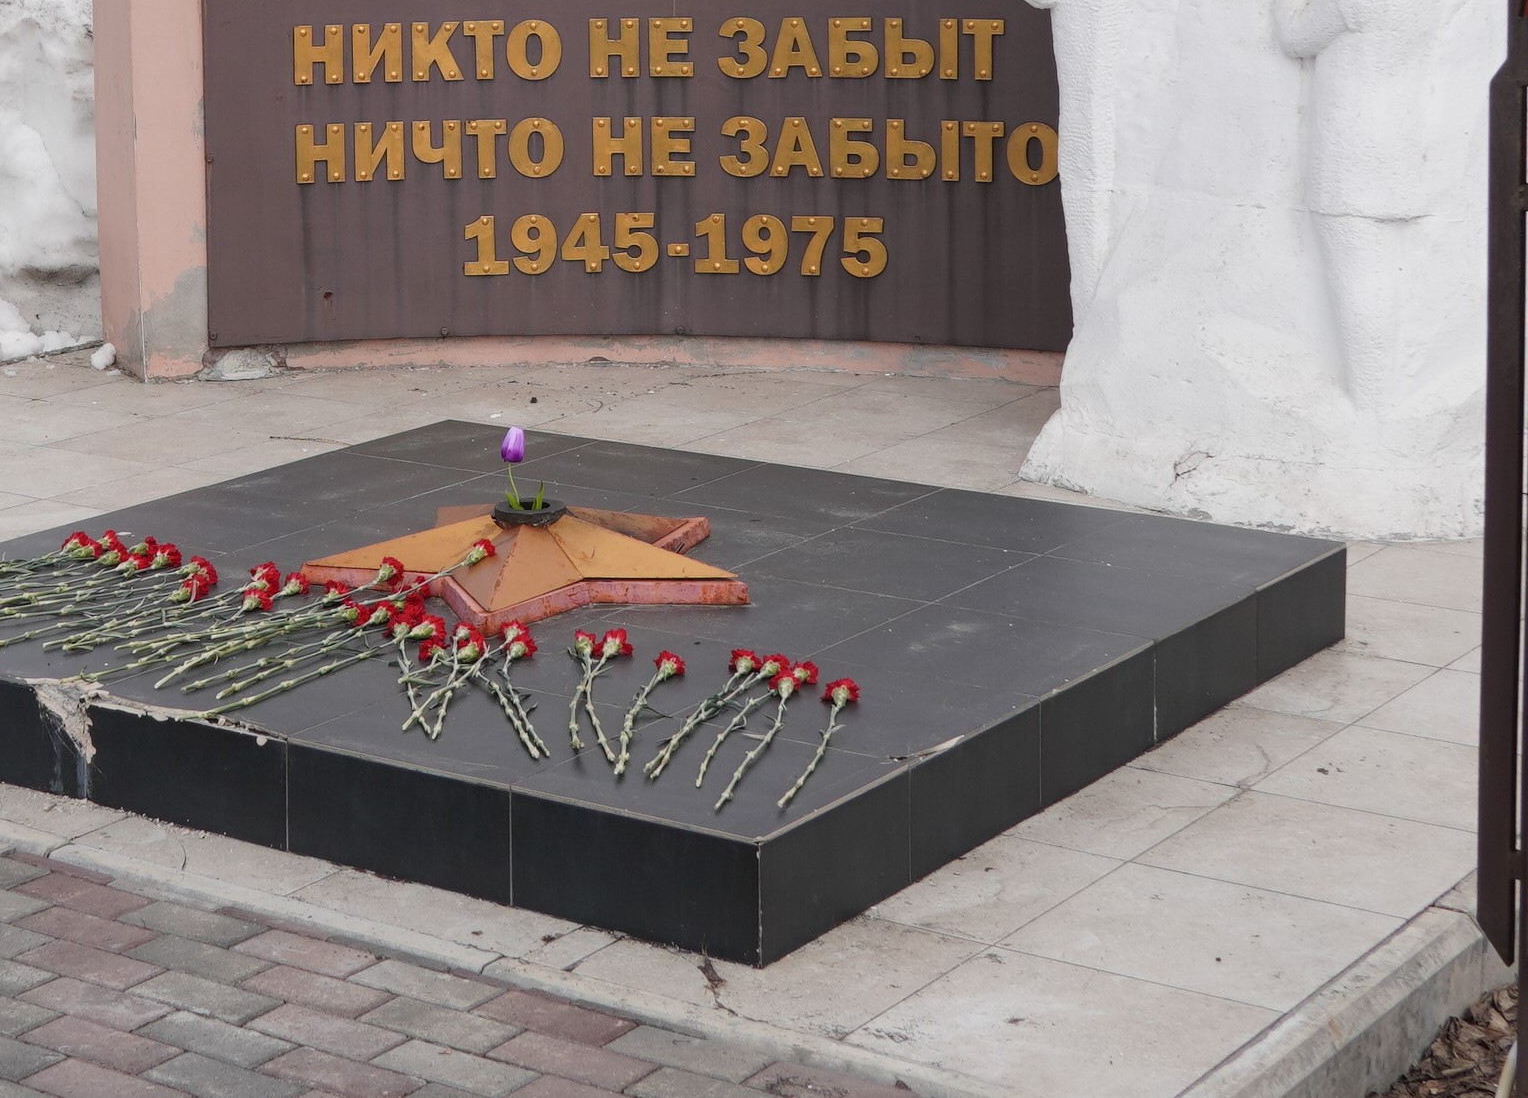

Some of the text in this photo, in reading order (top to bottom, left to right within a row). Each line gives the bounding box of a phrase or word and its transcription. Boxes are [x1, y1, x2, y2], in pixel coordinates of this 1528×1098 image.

[293, 16, 1005, 86] НИКТО НЕ ЗАБЫТ
[295, 115, 1060, 186] НИЧТО НЕ ЗАБЫТО
[463, 212, 889, 279] 1945-1975
